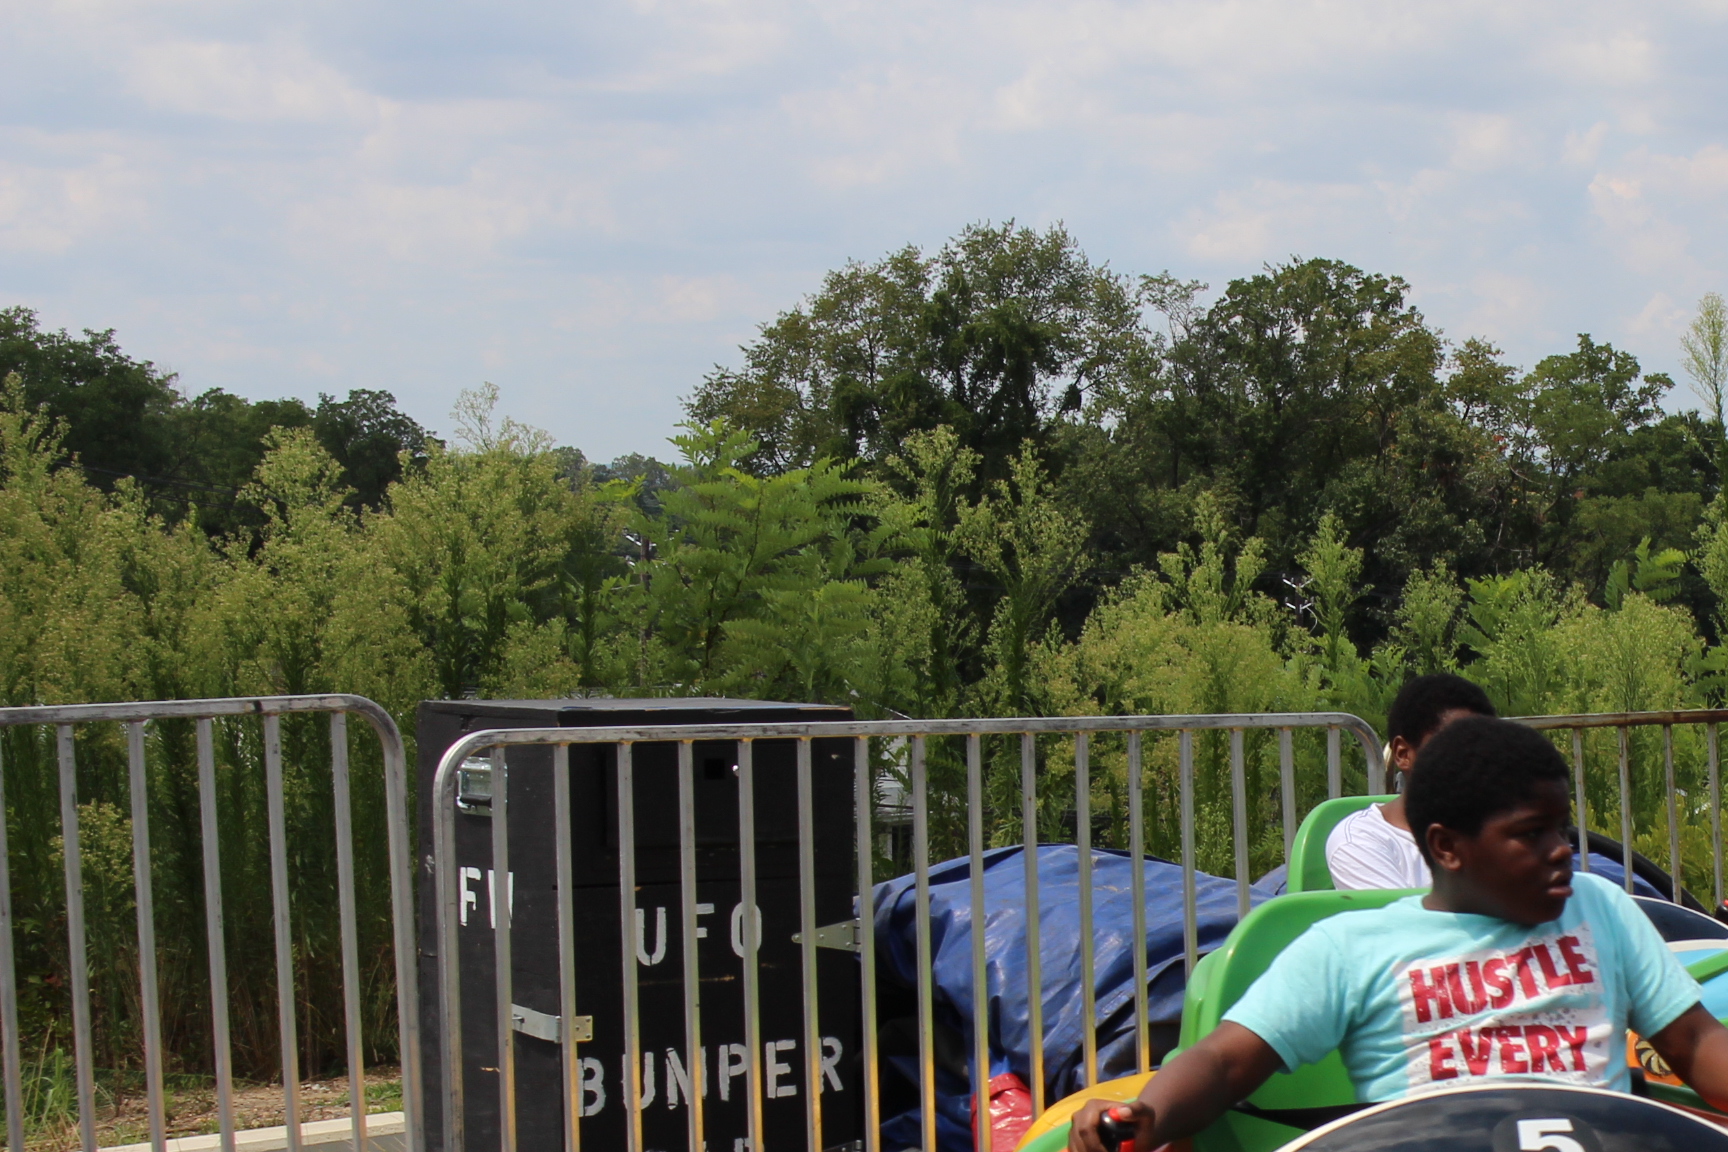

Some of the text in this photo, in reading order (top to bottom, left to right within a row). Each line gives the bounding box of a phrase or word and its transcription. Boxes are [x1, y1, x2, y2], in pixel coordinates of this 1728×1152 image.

[634, 901, 763, 967] UFO
[1408, 935, 1595, 1025] HUSTLE
[1428, 1024, 1588, 1081] EVERY
